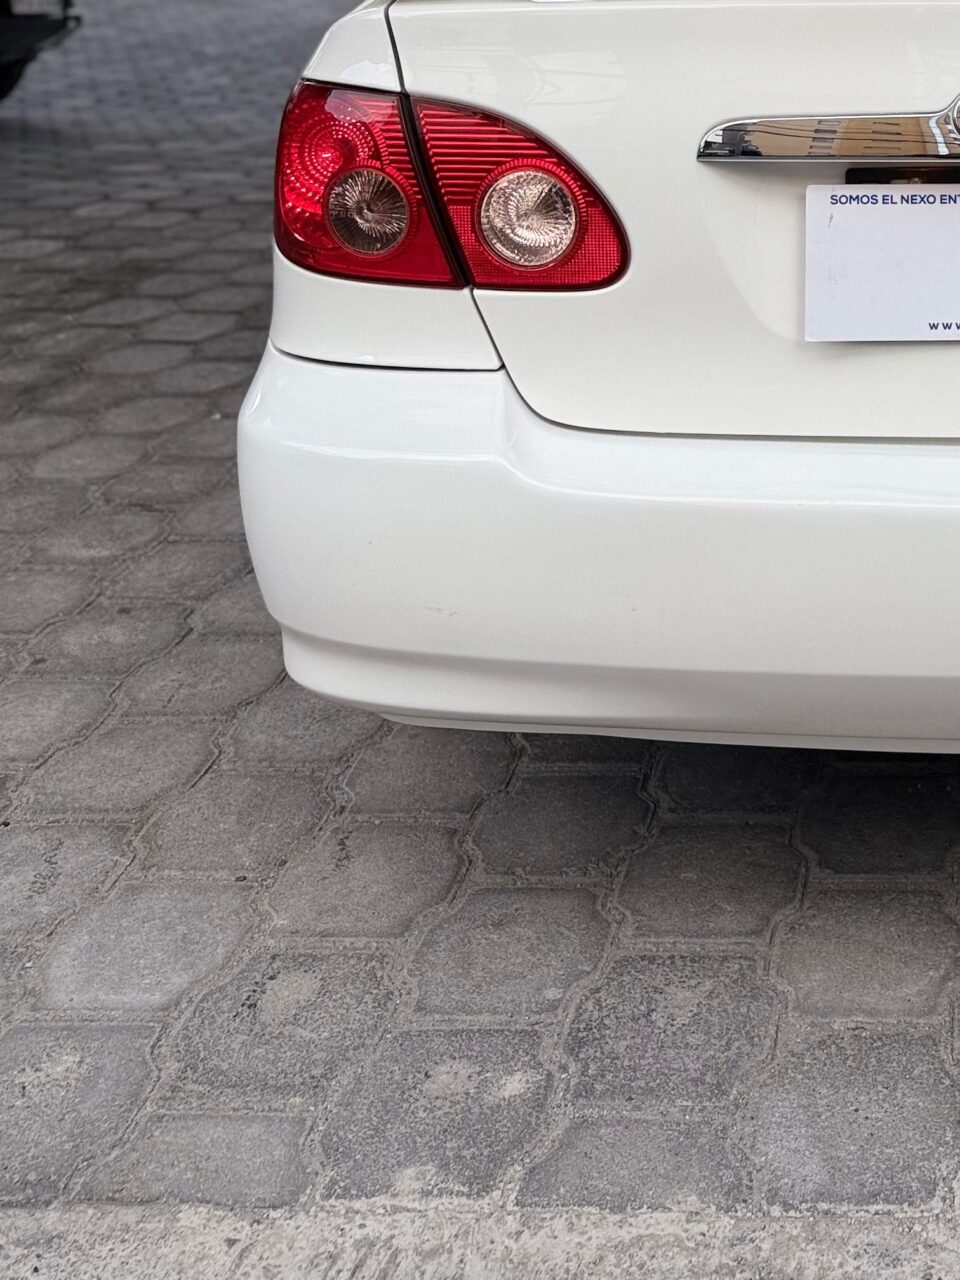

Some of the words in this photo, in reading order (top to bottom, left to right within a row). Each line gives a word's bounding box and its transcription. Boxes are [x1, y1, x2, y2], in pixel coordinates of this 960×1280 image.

[830, 194, 879, 205] SOMOS
[881, 194, 898, 205] EL
[900, 194, 937, 205] NEXO
